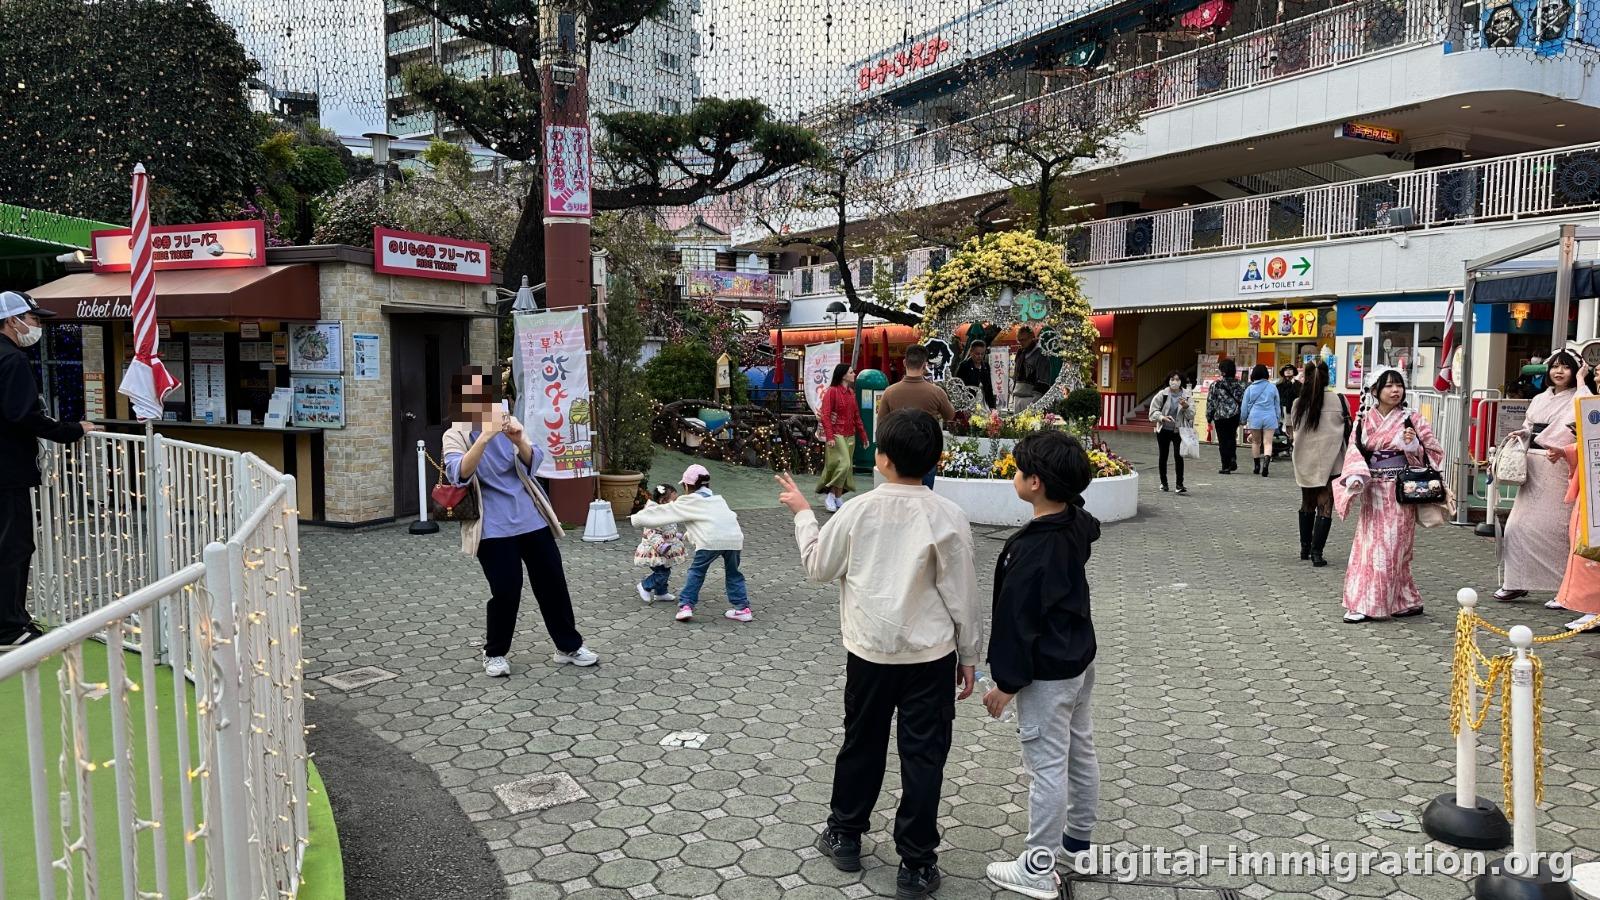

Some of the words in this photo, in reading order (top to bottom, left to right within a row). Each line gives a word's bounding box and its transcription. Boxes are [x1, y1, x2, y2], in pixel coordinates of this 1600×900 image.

[572, 132, 585, 191] フリーパス
[174, 233, 218, 248] フリーパス
[153, 250, 169, 261] RIDE
[170, 249, 194, 260] TICKET
[388, 240, 436, 259] のりもの券
[438, 247, 481, 264] フリーパス
[416, 258, 433, 269] RIDE
[434, 260, 458, 272] TICKET
[76, 297, 110, 318] ticket
